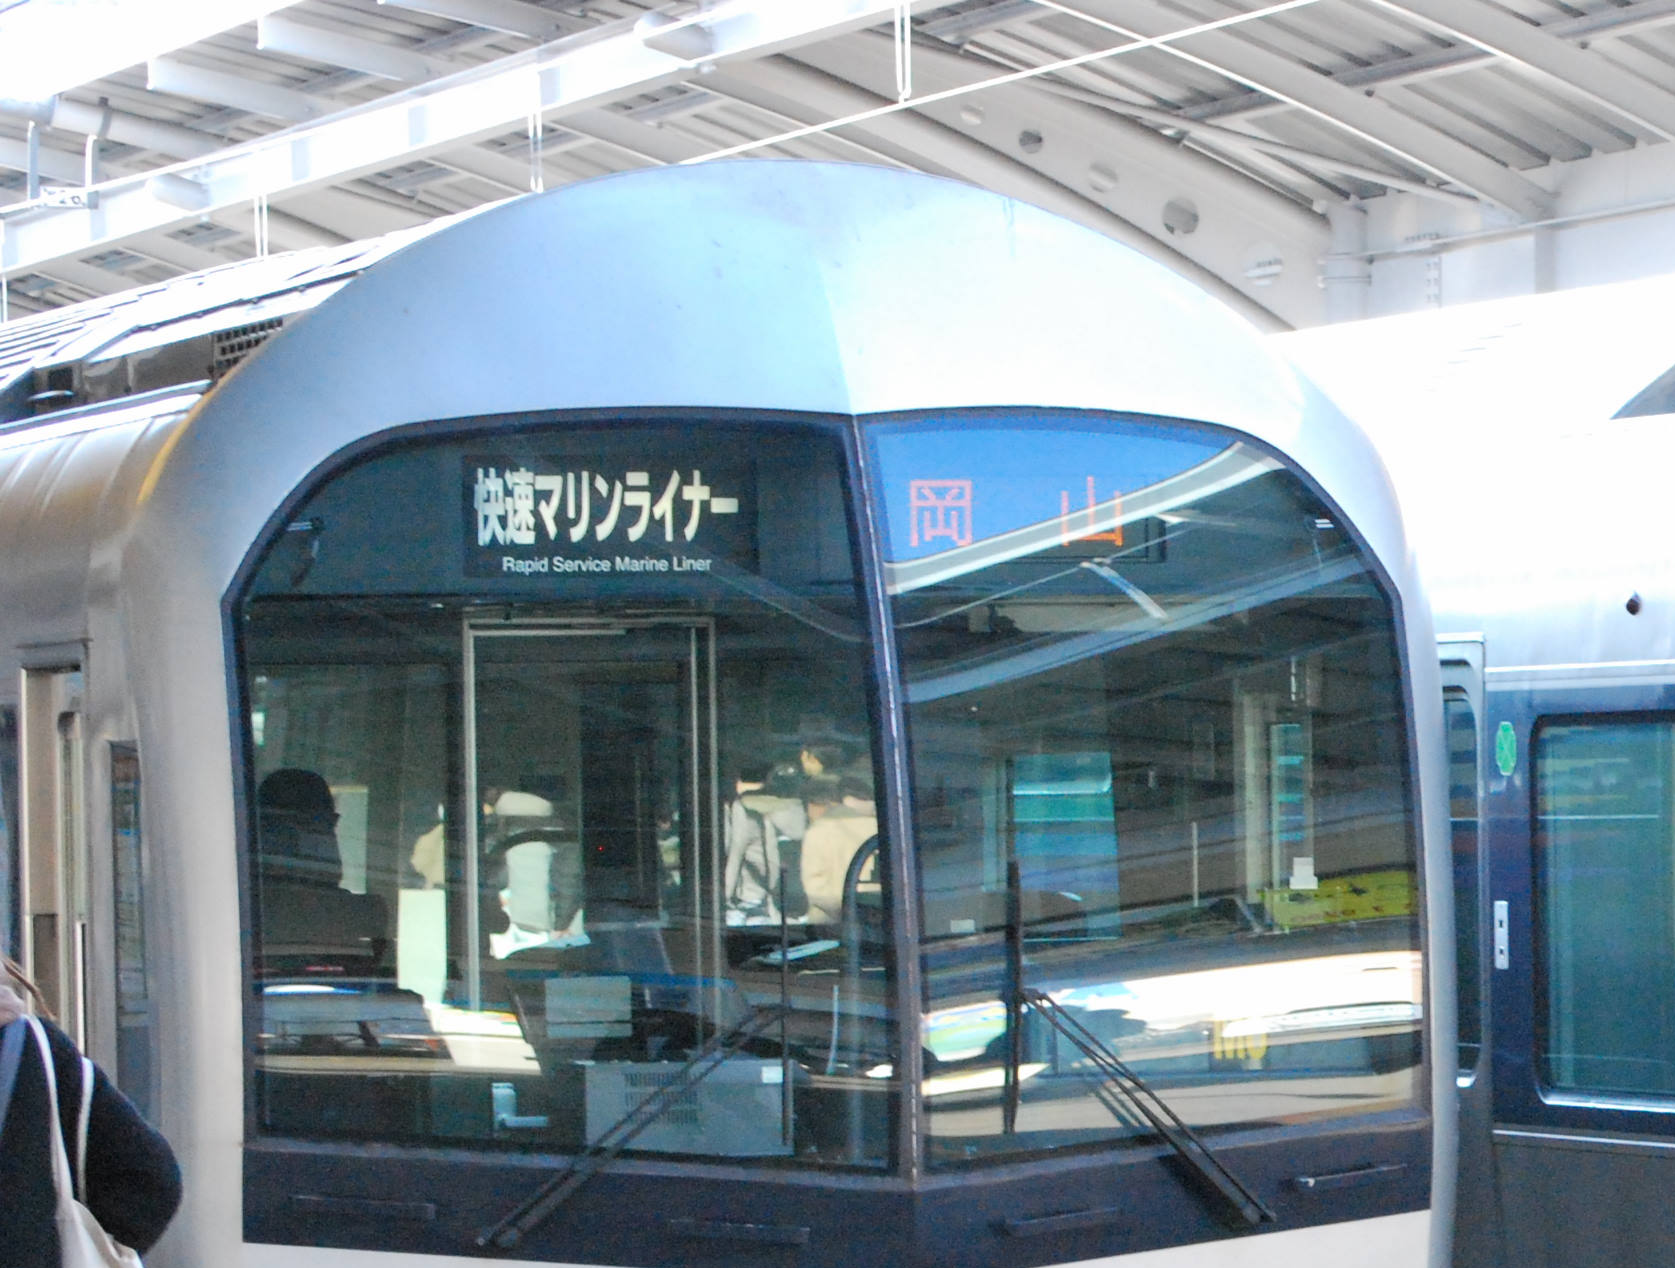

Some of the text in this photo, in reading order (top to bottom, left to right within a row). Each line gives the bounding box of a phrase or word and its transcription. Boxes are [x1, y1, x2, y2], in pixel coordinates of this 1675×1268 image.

[473, 467, 739, 546] 快速マリンライナー
[909, 476, 1124, 547] 岡山
[502, 556, 712, 575] Rapid Service Marine Liner
